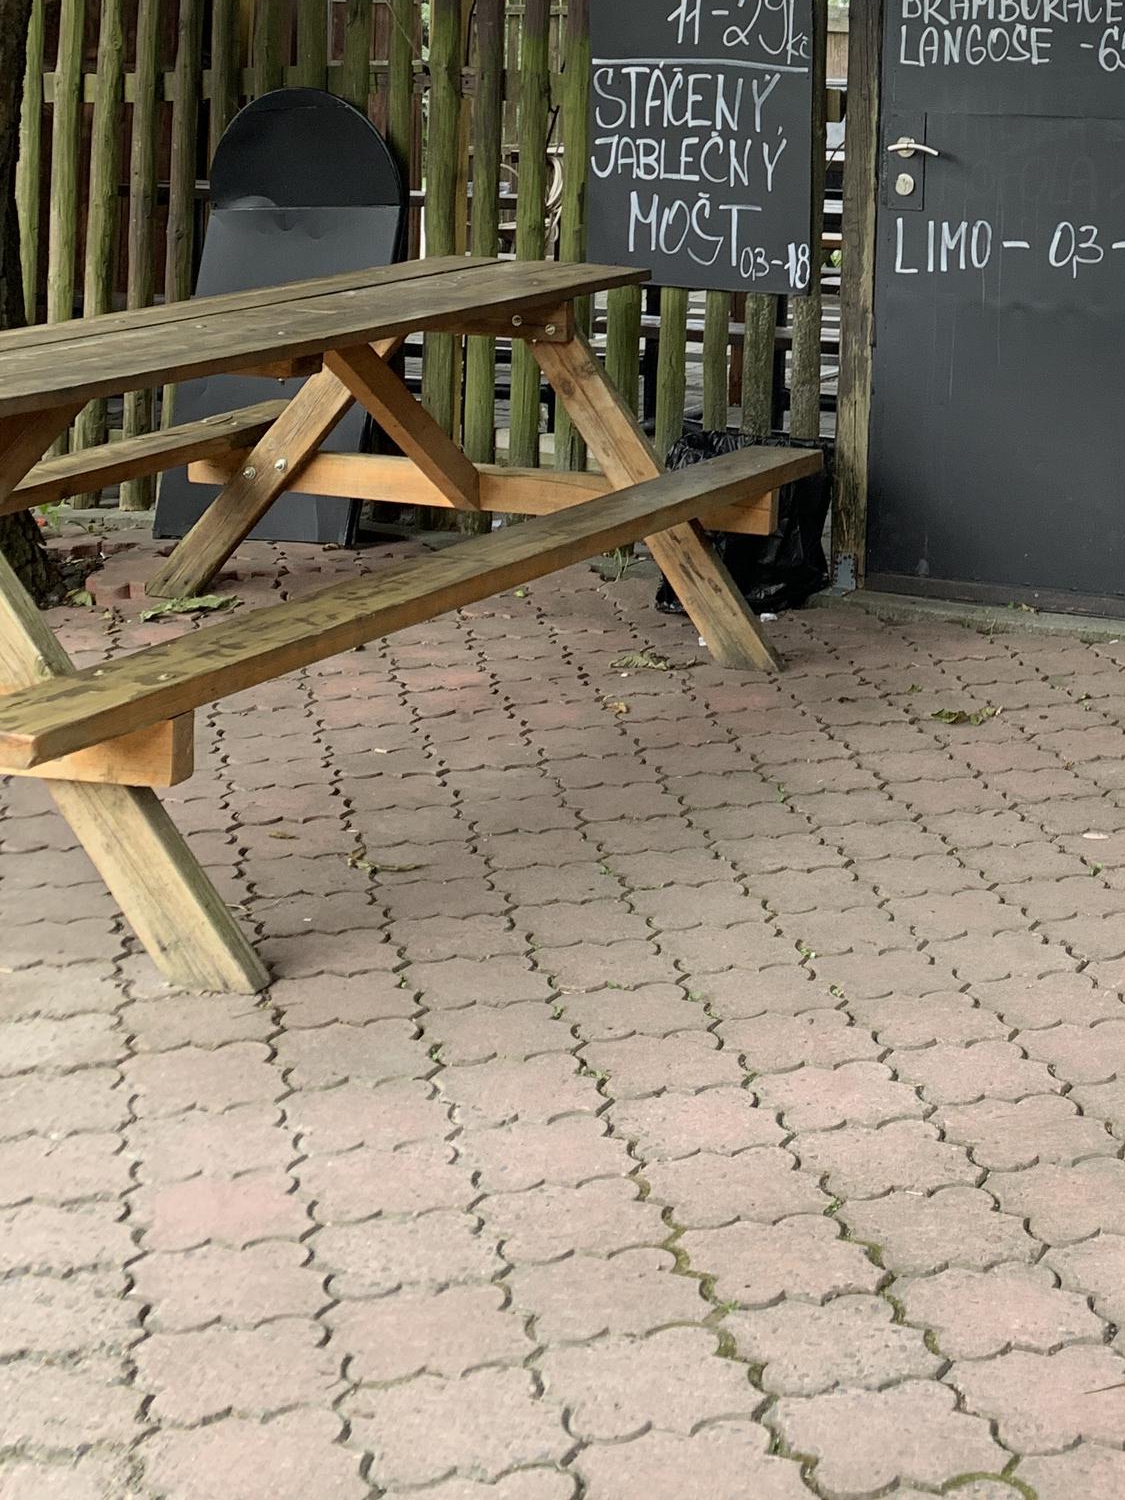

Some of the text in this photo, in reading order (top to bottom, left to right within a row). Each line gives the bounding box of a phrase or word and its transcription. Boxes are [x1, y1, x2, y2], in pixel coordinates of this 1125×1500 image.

[594, 61, 781, 132] STÁČENÝ
[591, 126, 787, 191] JABLEČNÝ
[628, 192, 762, 267] MOŠT
[895, 217, 992, 274] LIMO
